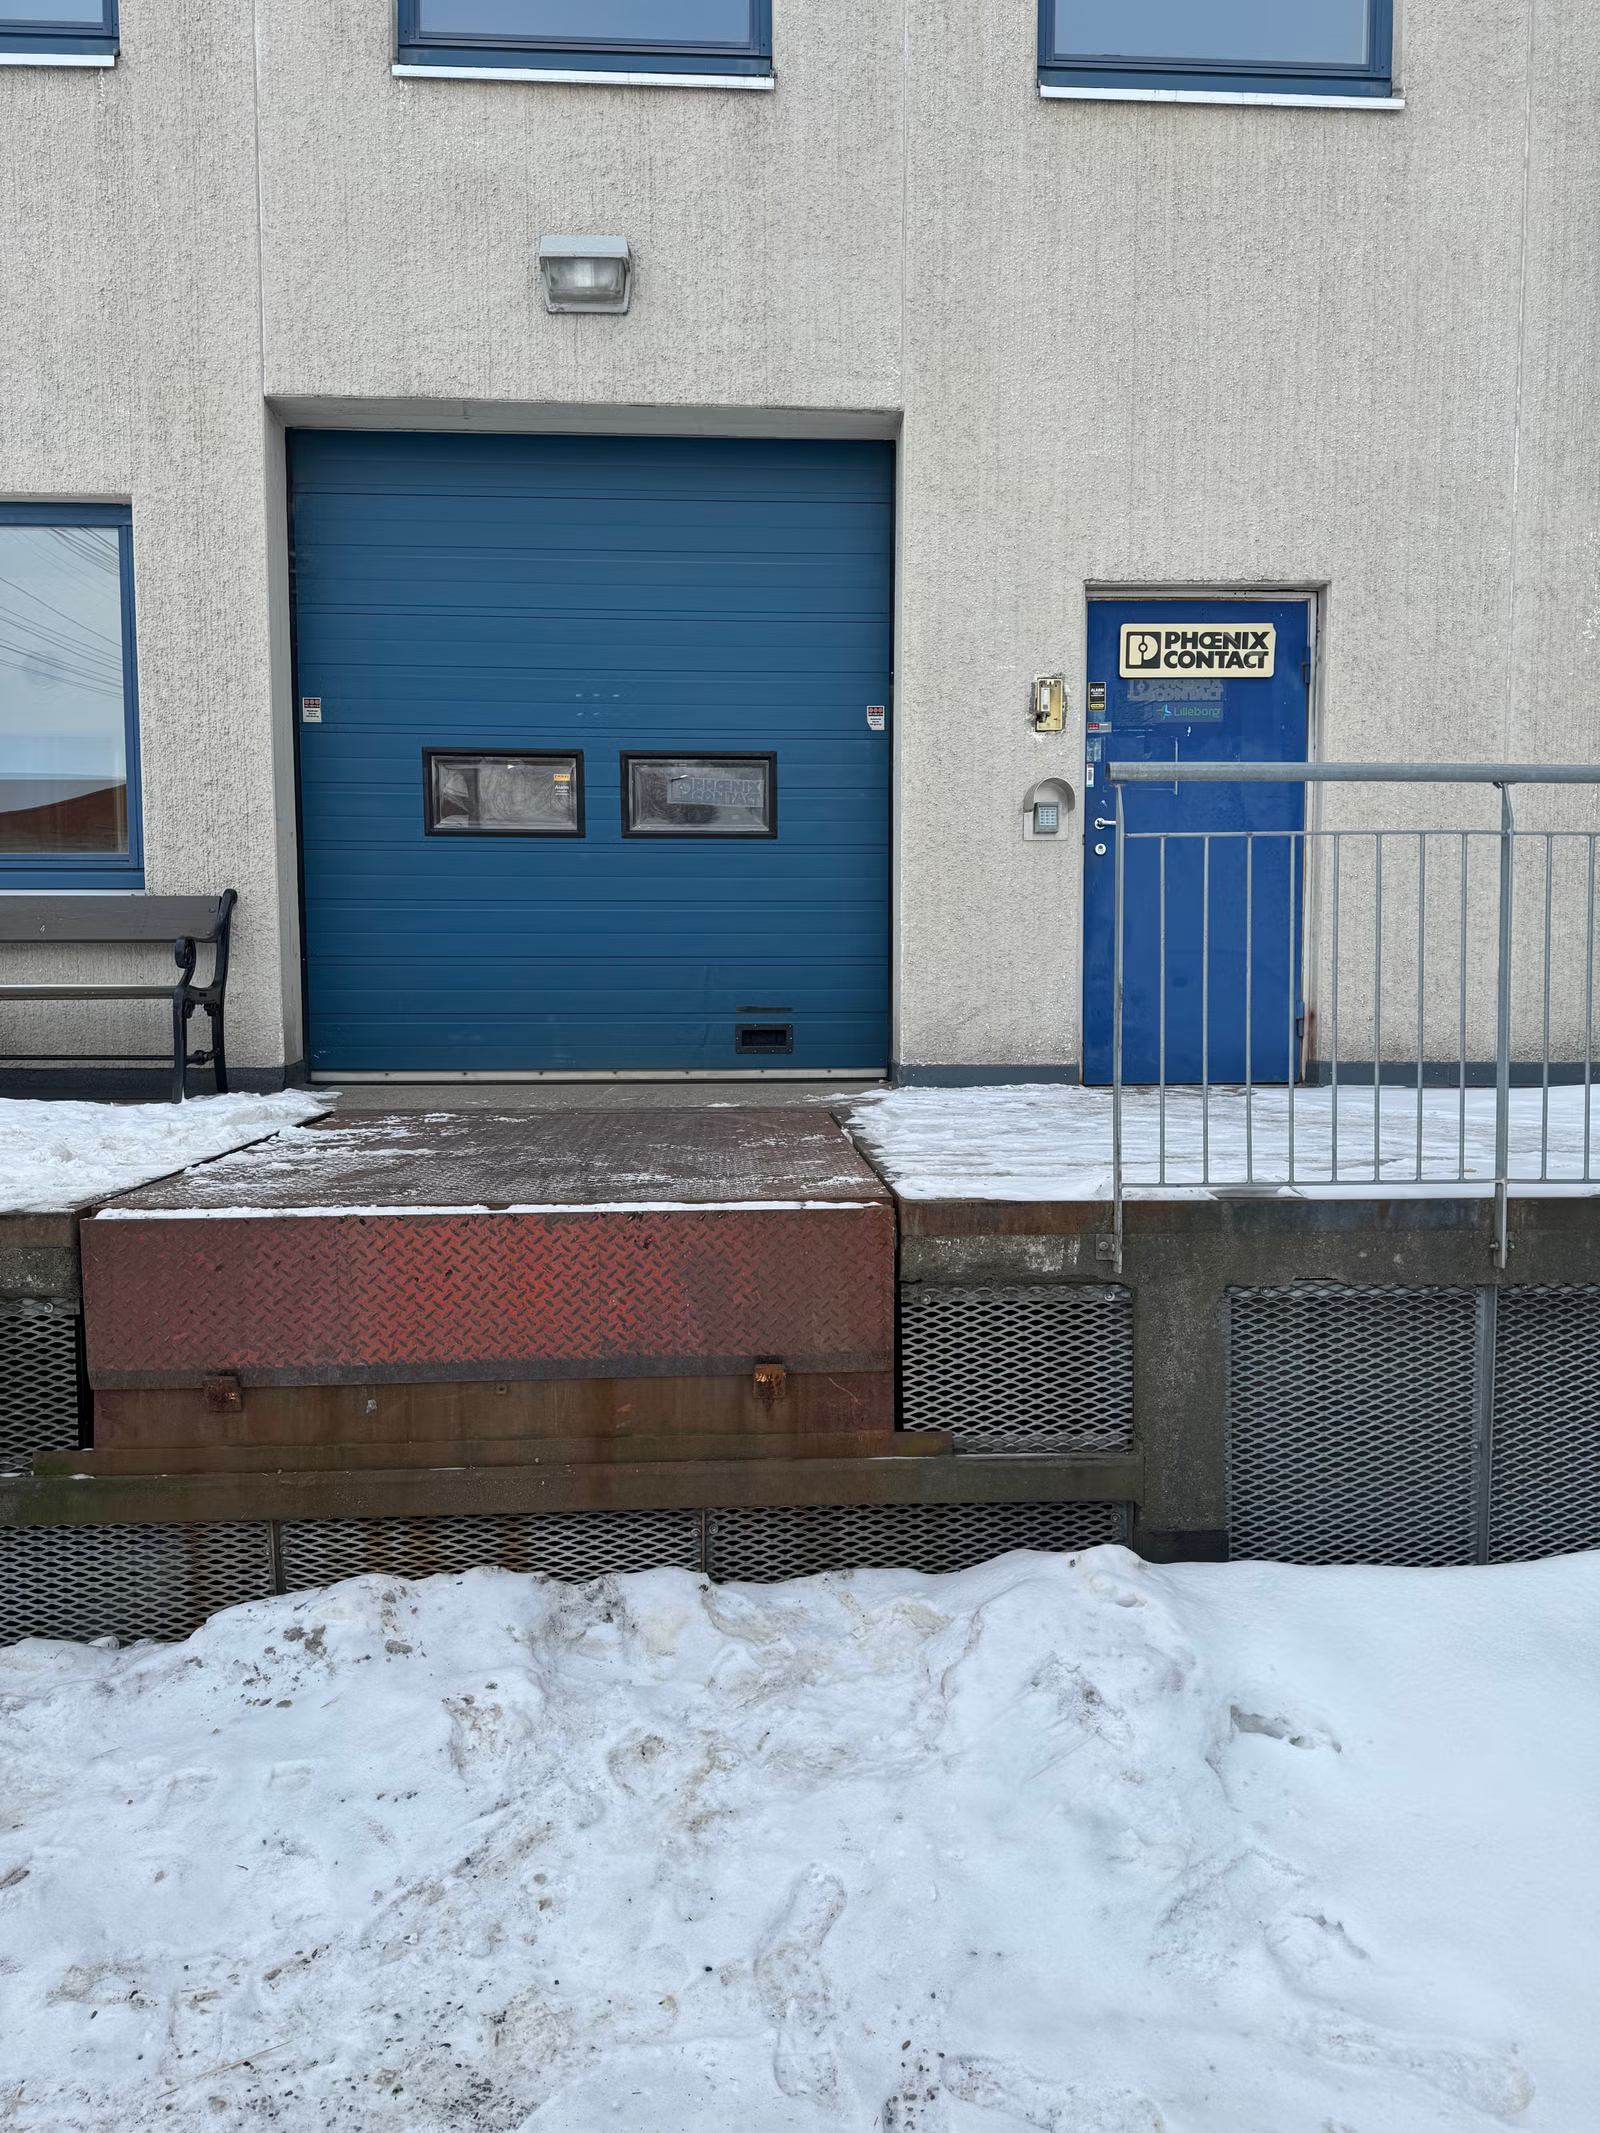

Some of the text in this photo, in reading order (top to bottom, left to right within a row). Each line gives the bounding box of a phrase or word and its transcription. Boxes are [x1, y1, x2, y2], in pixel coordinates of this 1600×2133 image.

[1164, 631, 1271, 650] PHŒNIX
[1163, 651, 1269, 669] CONTACT
[1174, 707, 1221, 718] Lilleborg
